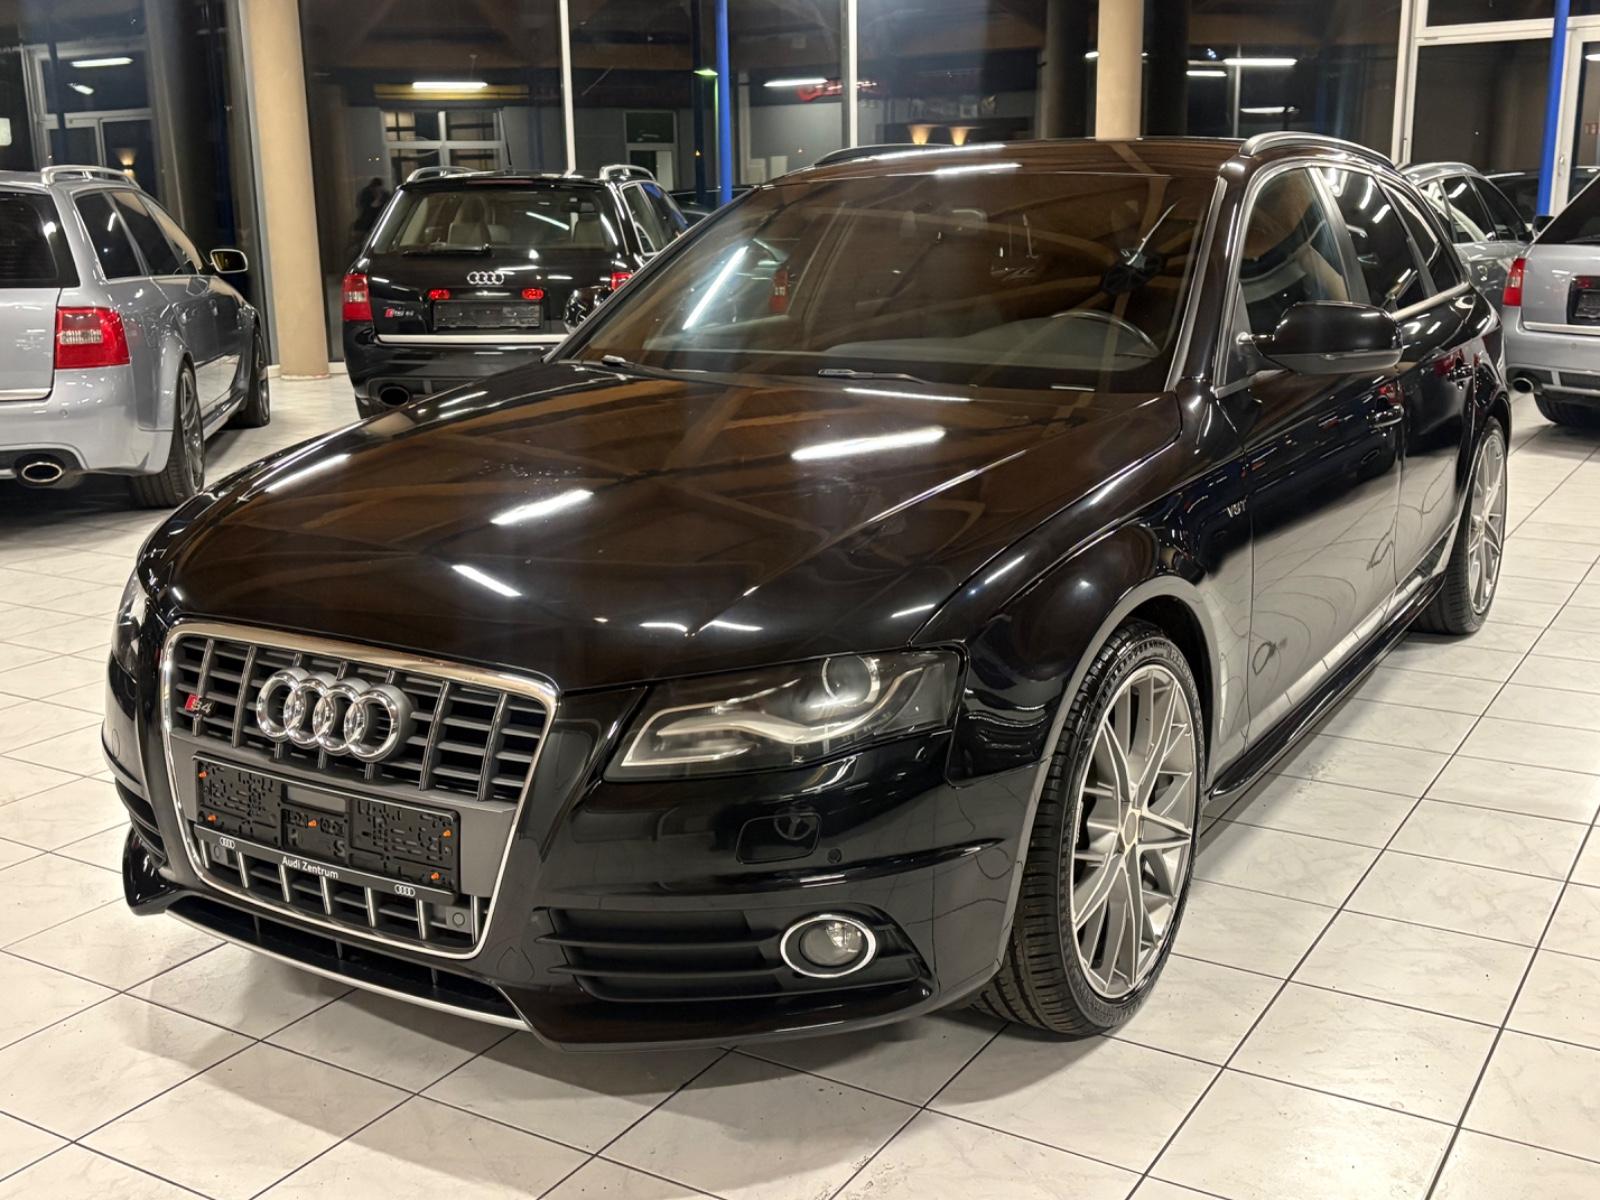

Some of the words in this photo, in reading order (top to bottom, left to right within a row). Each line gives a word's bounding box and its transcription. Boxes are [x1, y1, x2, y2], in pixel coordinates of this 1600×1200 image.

[190, 697, 212, 713] S4
[281, 855, 301, 870] Audi
[301, 860, 339, 879] Zentrum
